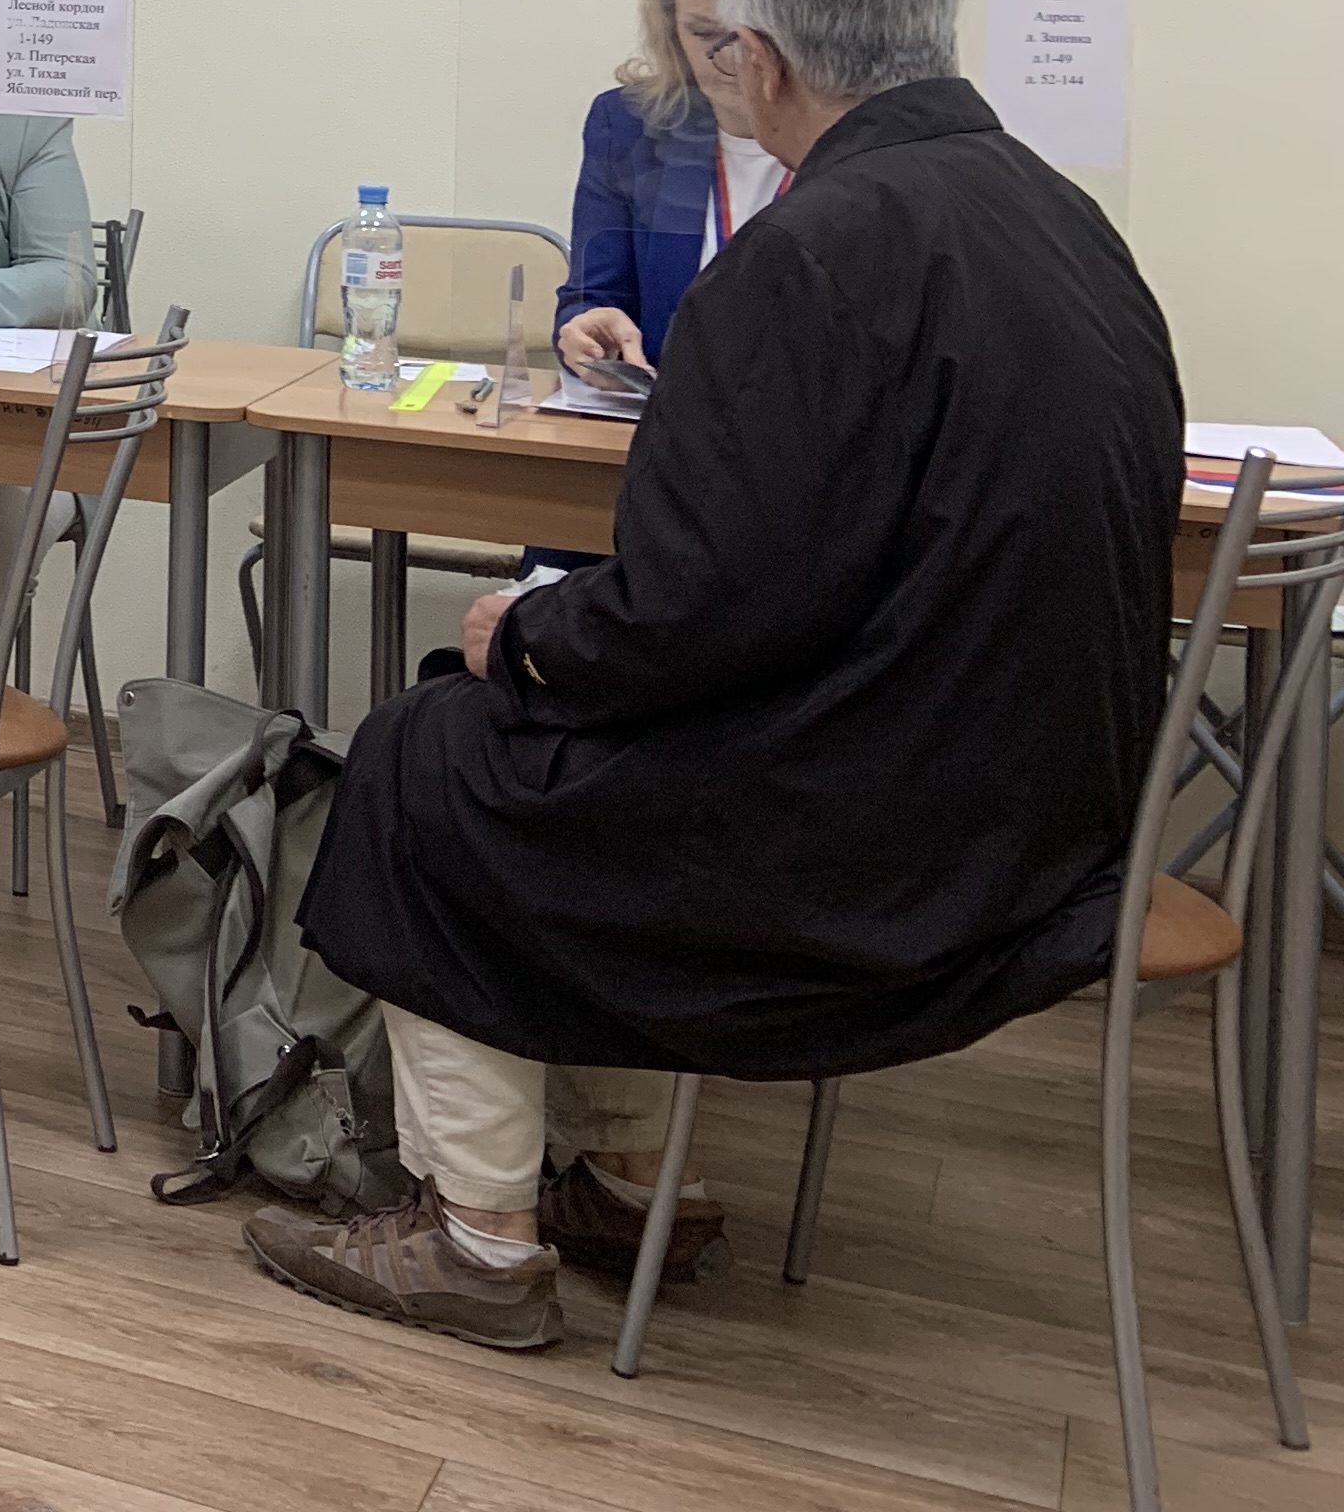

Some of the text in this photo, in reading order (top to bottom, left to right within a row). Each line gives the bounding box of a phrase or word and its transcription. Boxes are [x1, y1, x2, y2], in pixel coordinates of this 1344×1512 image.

[58, 3, 105, 15] кордон
[19, 32, 53, 45] 1-149
[6, 49, 97, 65] ул. Питерская
[6, 66, 67, 79] ул. Тихая
[1040, 74, 1084, 85] 52-144
[6, 82, 121, 102] Яблоновский пер.
